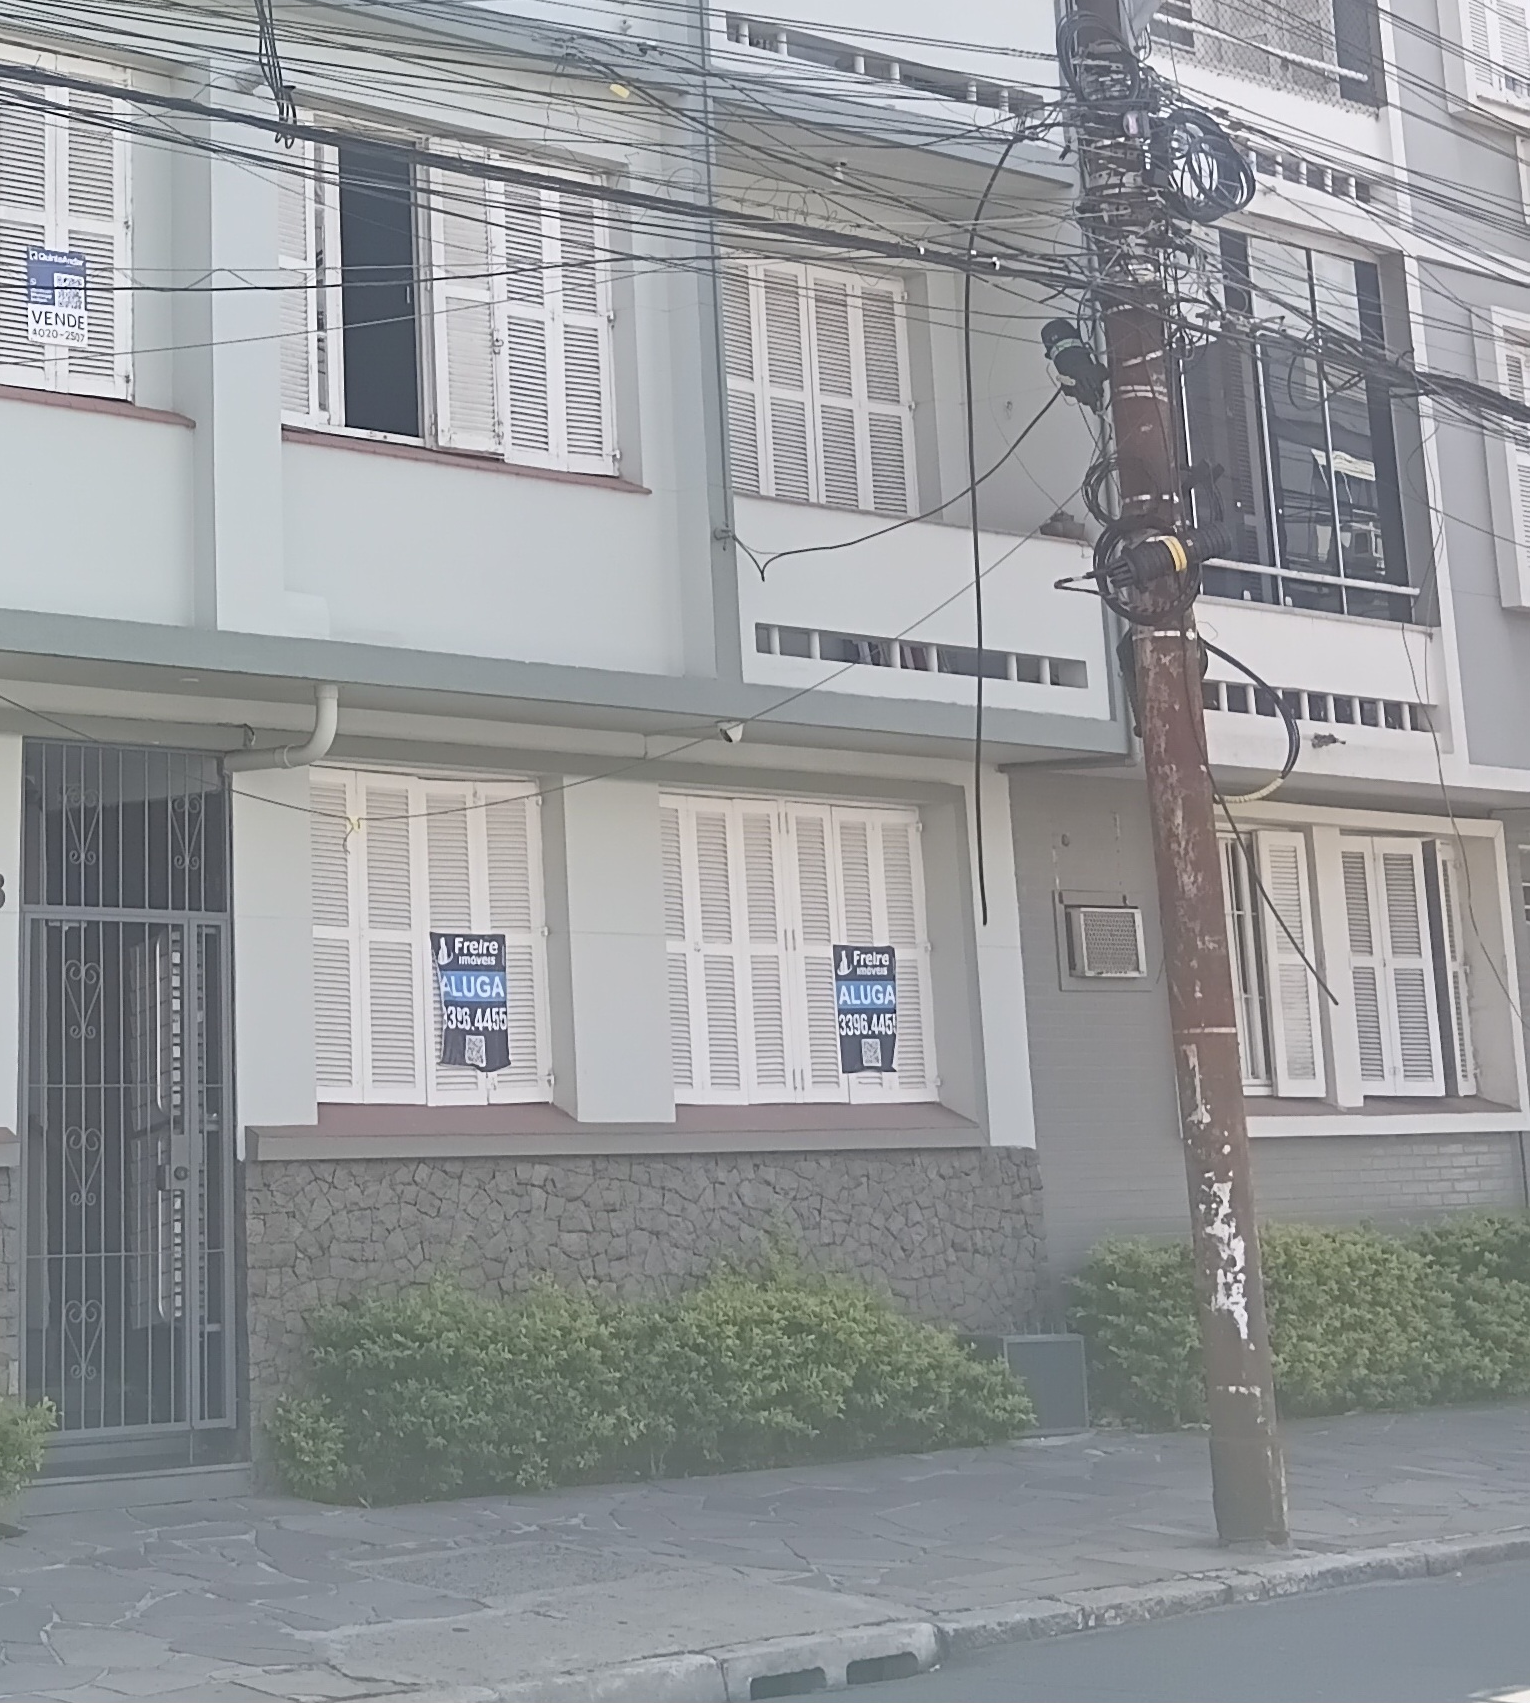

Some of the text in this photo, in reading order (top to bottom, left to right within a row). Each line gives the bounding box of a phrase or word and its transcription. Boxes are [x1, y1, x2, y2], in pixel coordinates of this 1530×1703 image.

[31, 310, 85, 331] VENDE
[454, 937, 498, 955] Freire
[853, 950, 889, 966] Freire
[441, 975, 505, 998] ALUGA
[839, 984, 896, 1005] ALUGA
